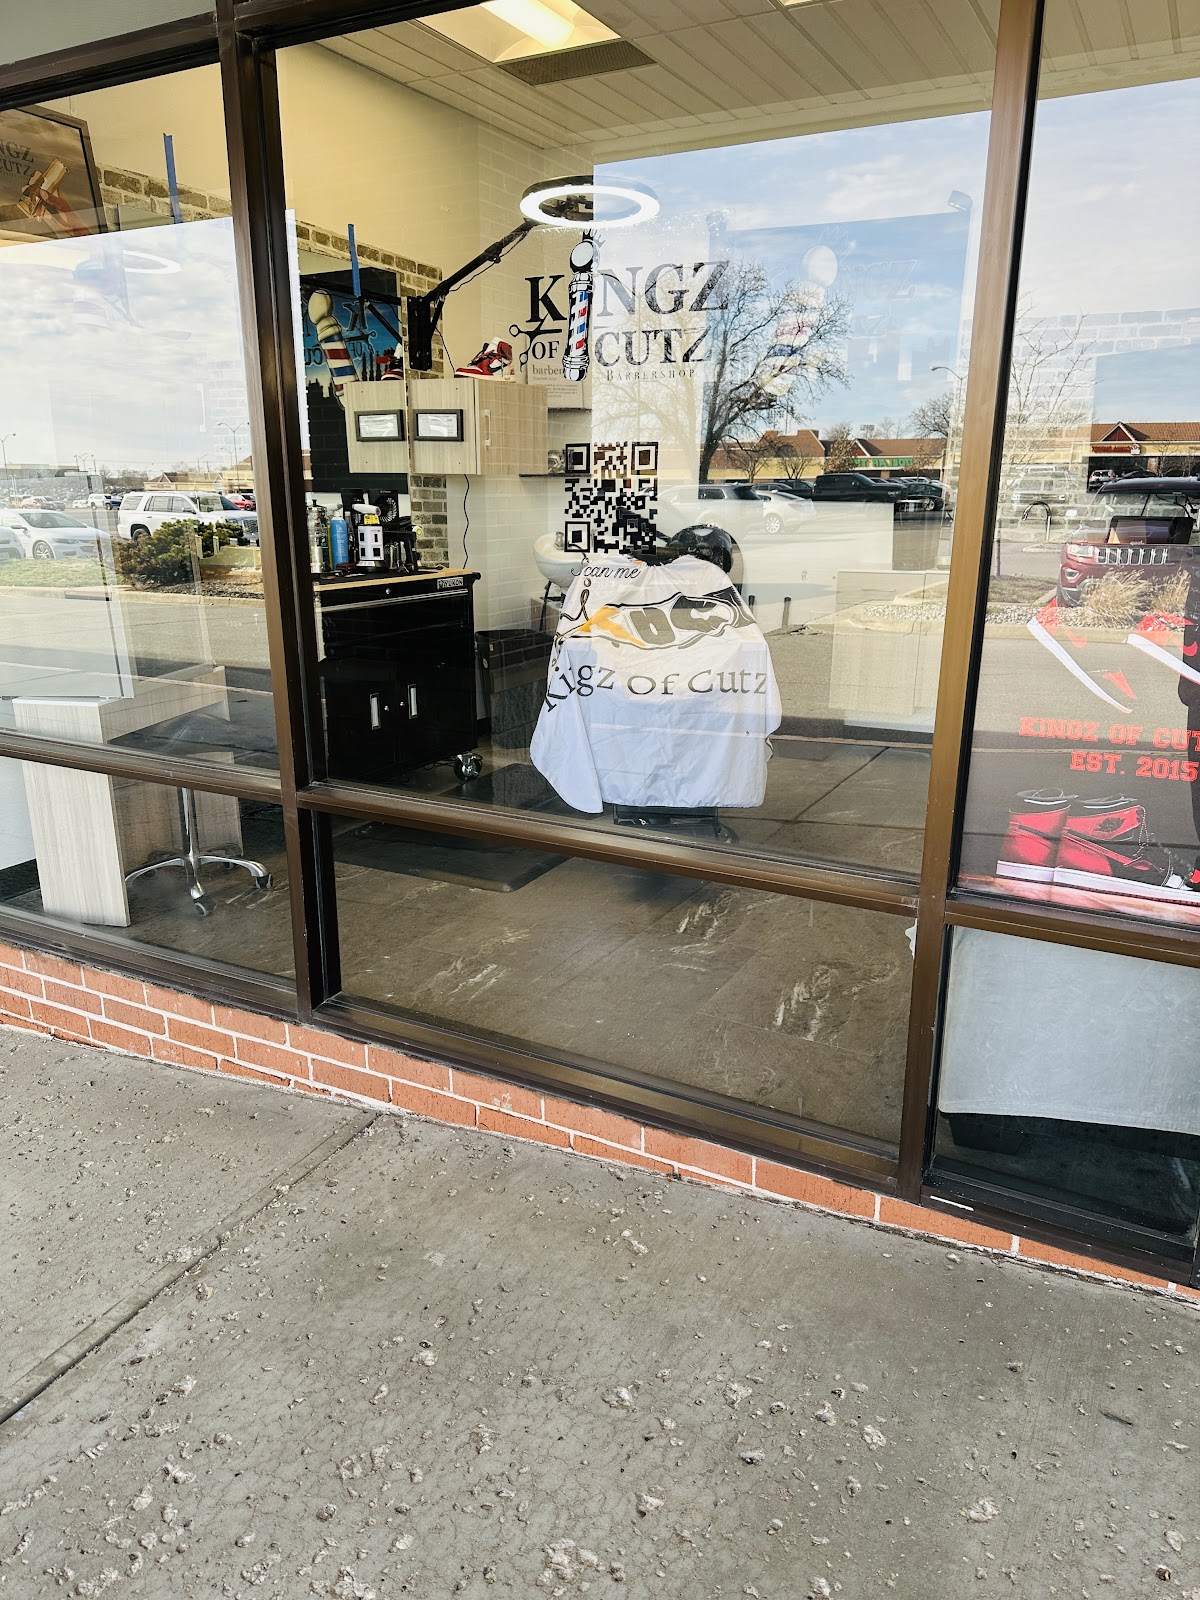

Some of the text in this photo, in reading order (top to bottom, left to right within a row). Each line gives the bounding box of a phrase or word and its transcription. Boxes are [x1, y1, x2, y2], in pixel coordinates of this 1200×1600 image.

[532, 325, 713, 367] OF CUTZ
[606, 368, 695, 381] BARBERSHOP
[613, 566, 642, 579] me
[1018, 716, 1100, 743] KINGZ
[1109, 723, 1144, 746] OF
[1069, 750, 1200, 782] EST. 2015
